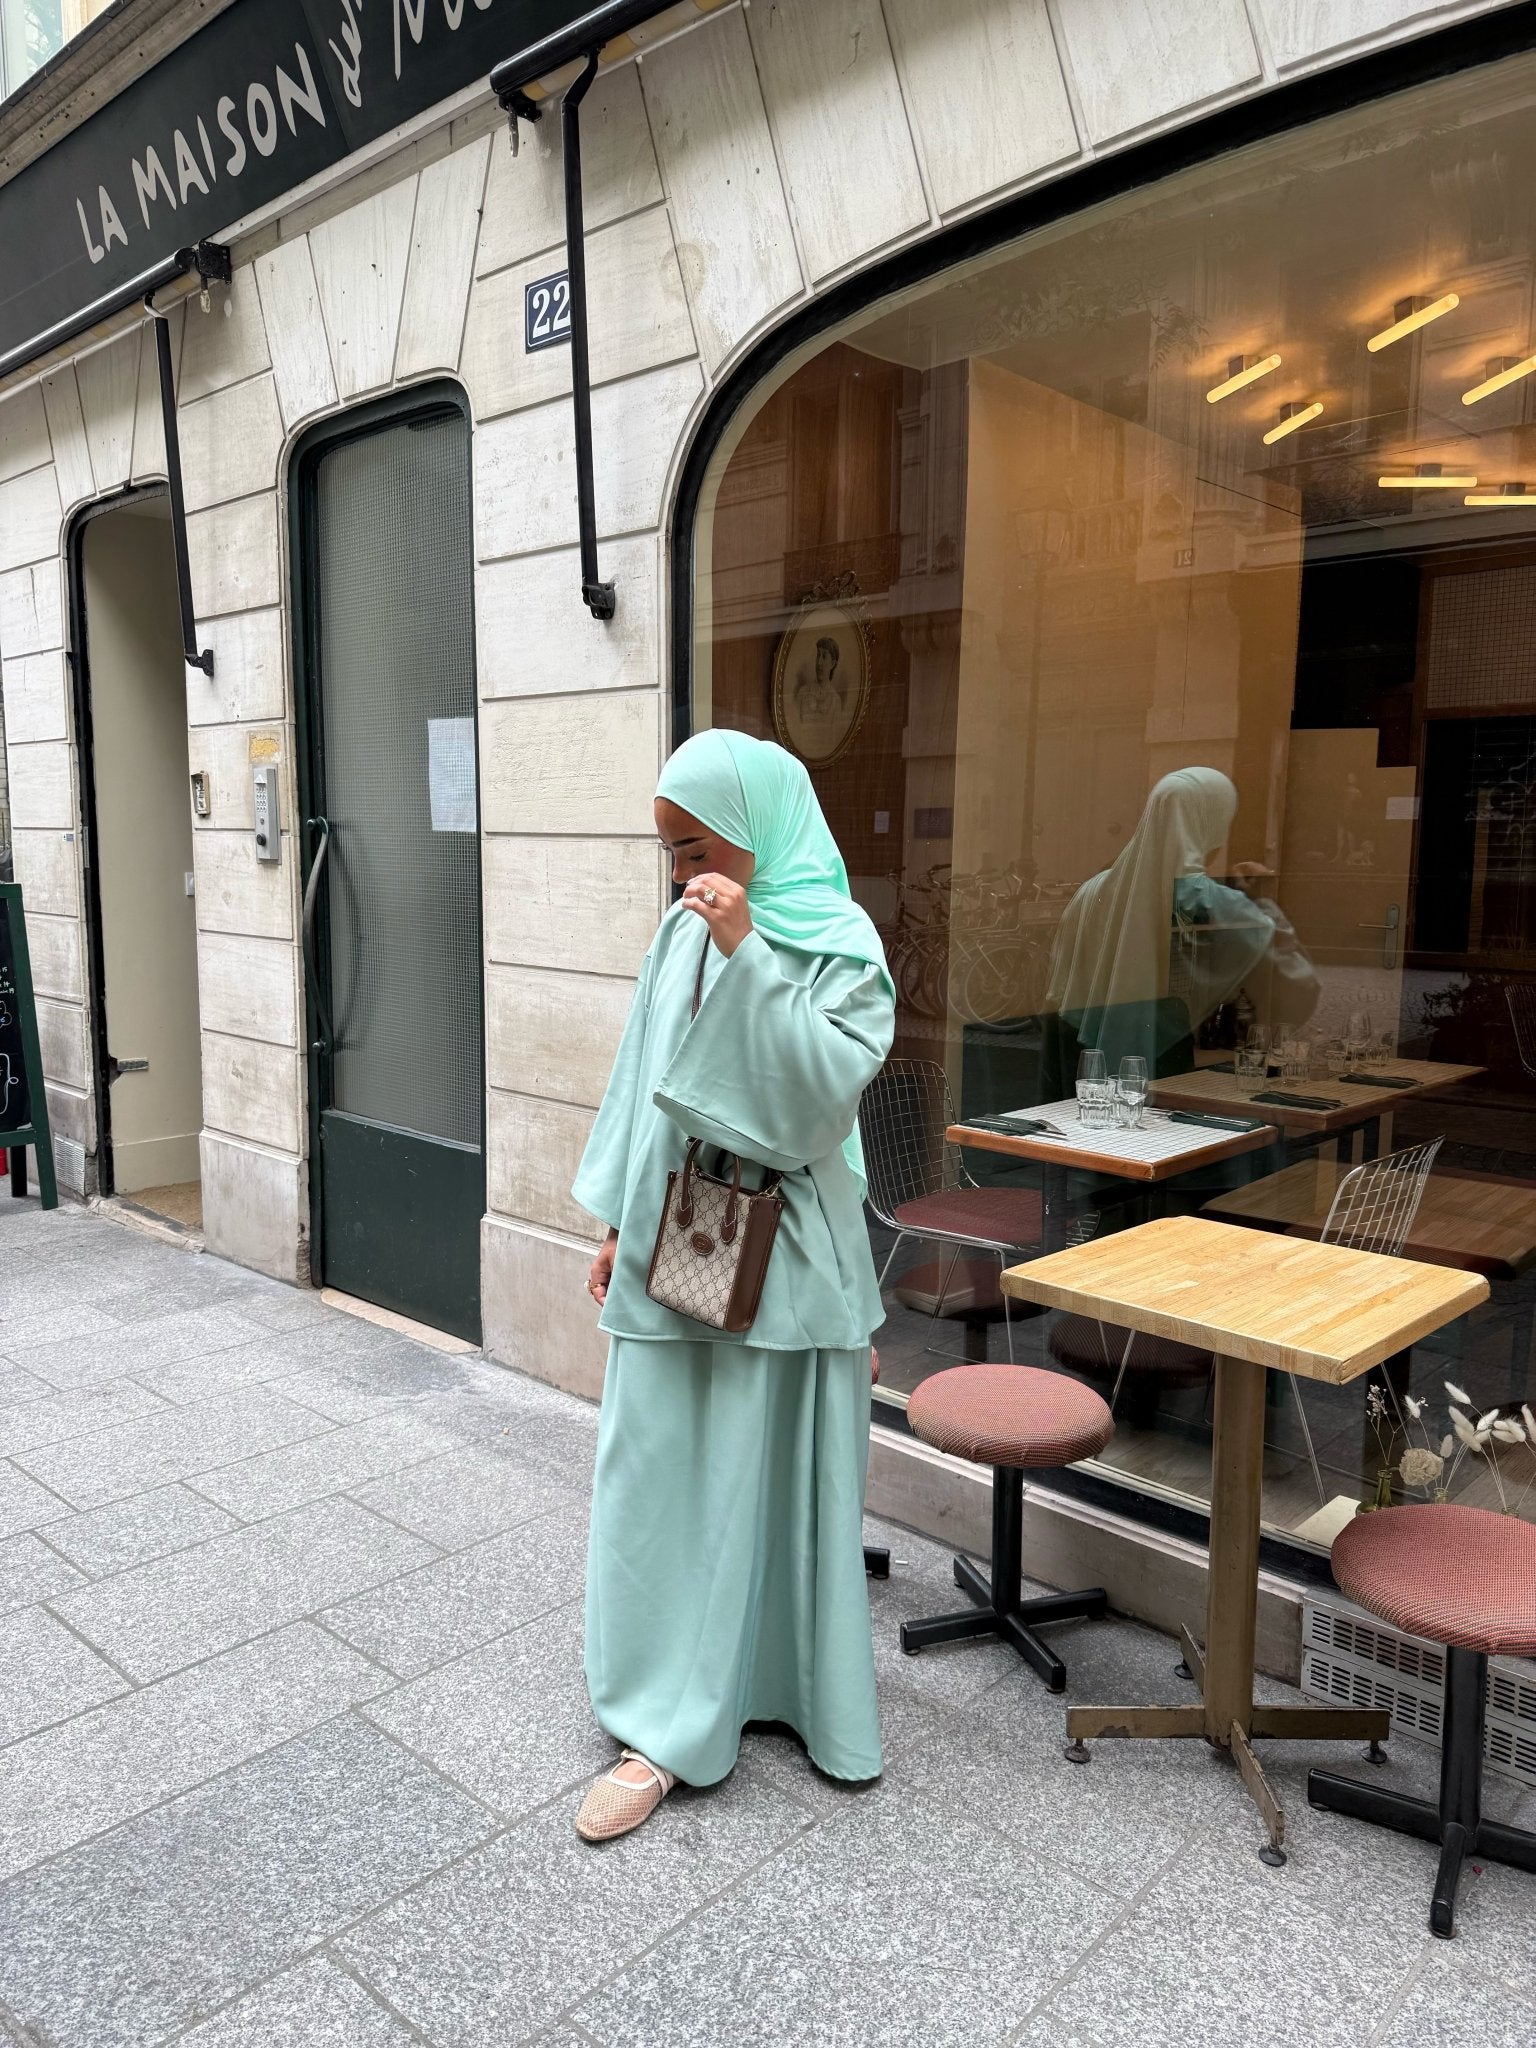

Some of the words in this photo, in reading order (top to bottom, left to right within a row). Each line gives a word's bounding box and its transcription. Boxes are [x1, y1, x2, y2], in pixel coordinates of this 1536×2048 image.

[76, 185, 128, 264] LA
[131, 42, 326, 230] MAISON
[532, 280, 571, 339] 22
